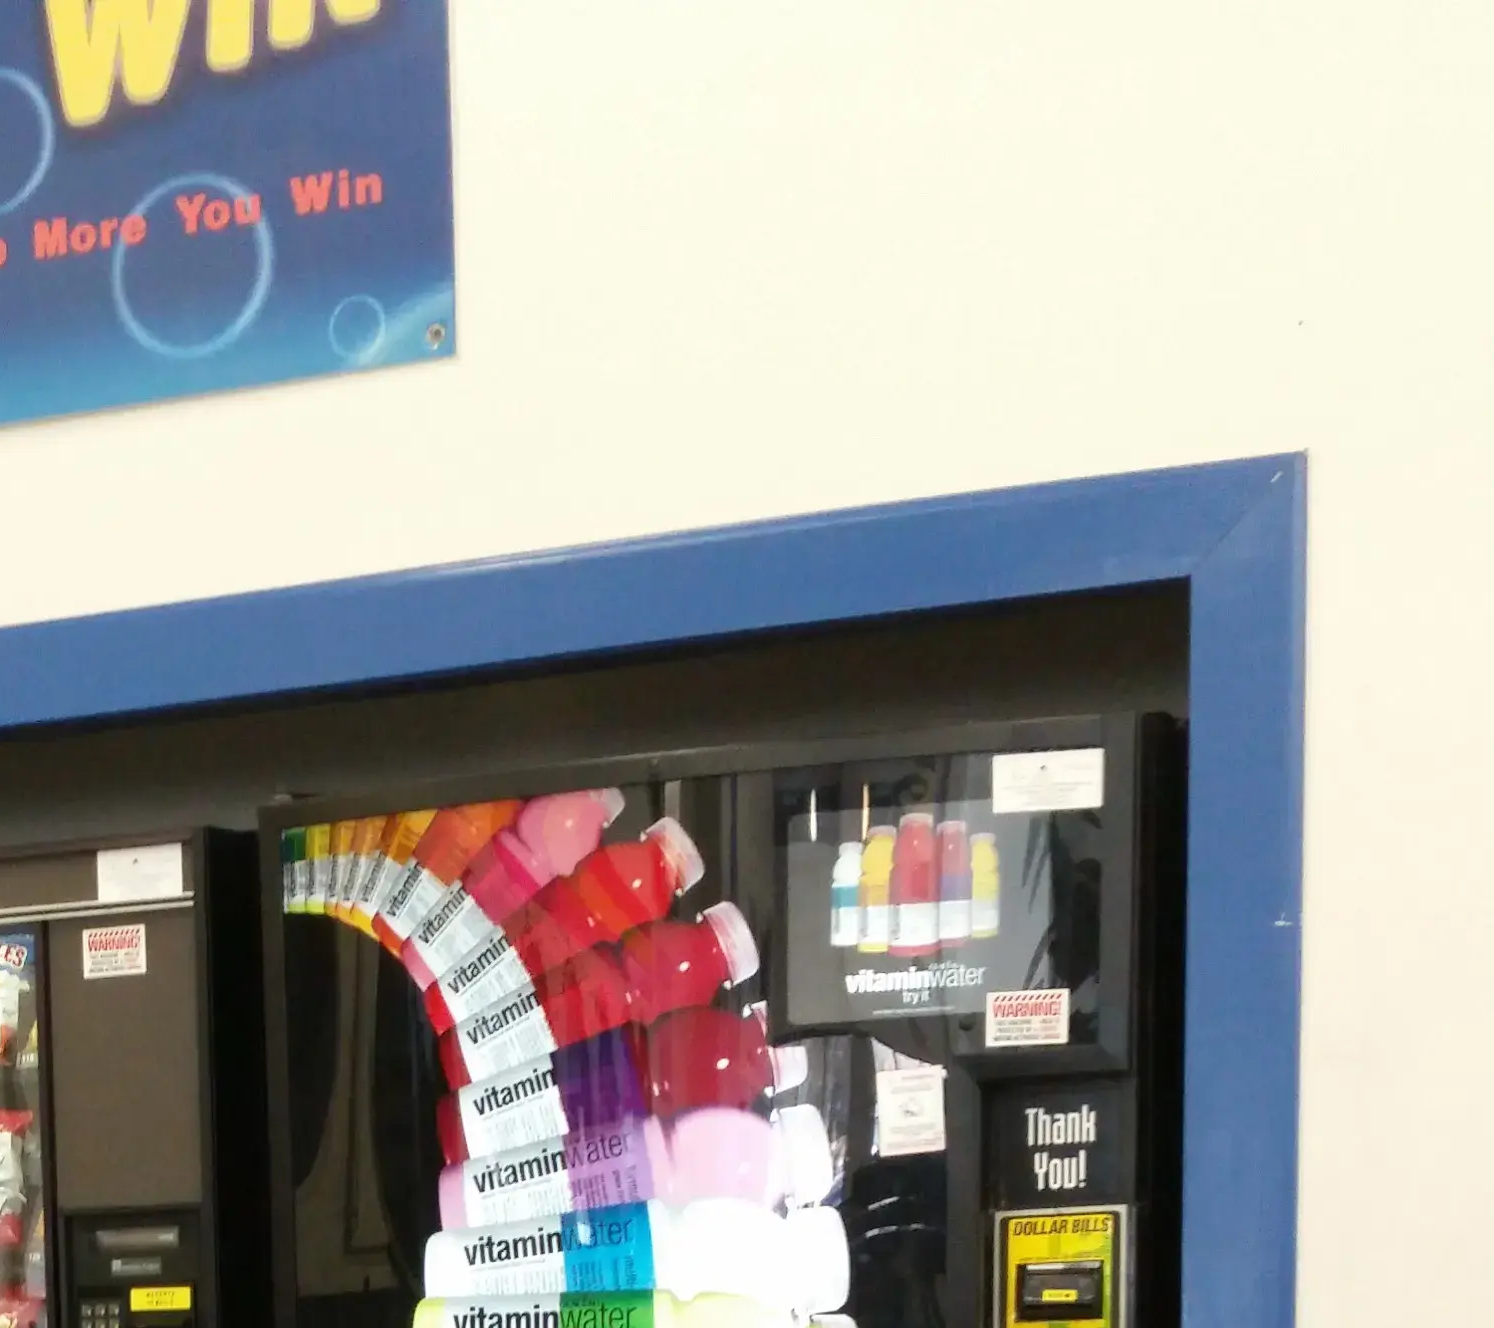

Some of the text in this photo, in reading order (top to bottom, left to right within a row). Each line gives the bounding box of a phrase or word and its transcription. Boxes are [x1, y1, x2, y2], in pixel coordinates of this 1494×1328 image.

[32, 214, 147, 260] More
[175, 193, 262, 234] You
[289, 168, 383, 215] Win
[418, 886, 469, 945] vitamin
[447, 934, 510, 994] vitamin
[844, 964, 987, 993] vitaminwater
[466, 991, 541, 1045] vitamin
[993, 1001, 1062, 1018] WARNING!
[1025, 1104, 1097, 1147] Thank
[1033, 1148, 1087, 1192] You!
[1013, 1216, 1110, 1237] DOLLAR BILLS
